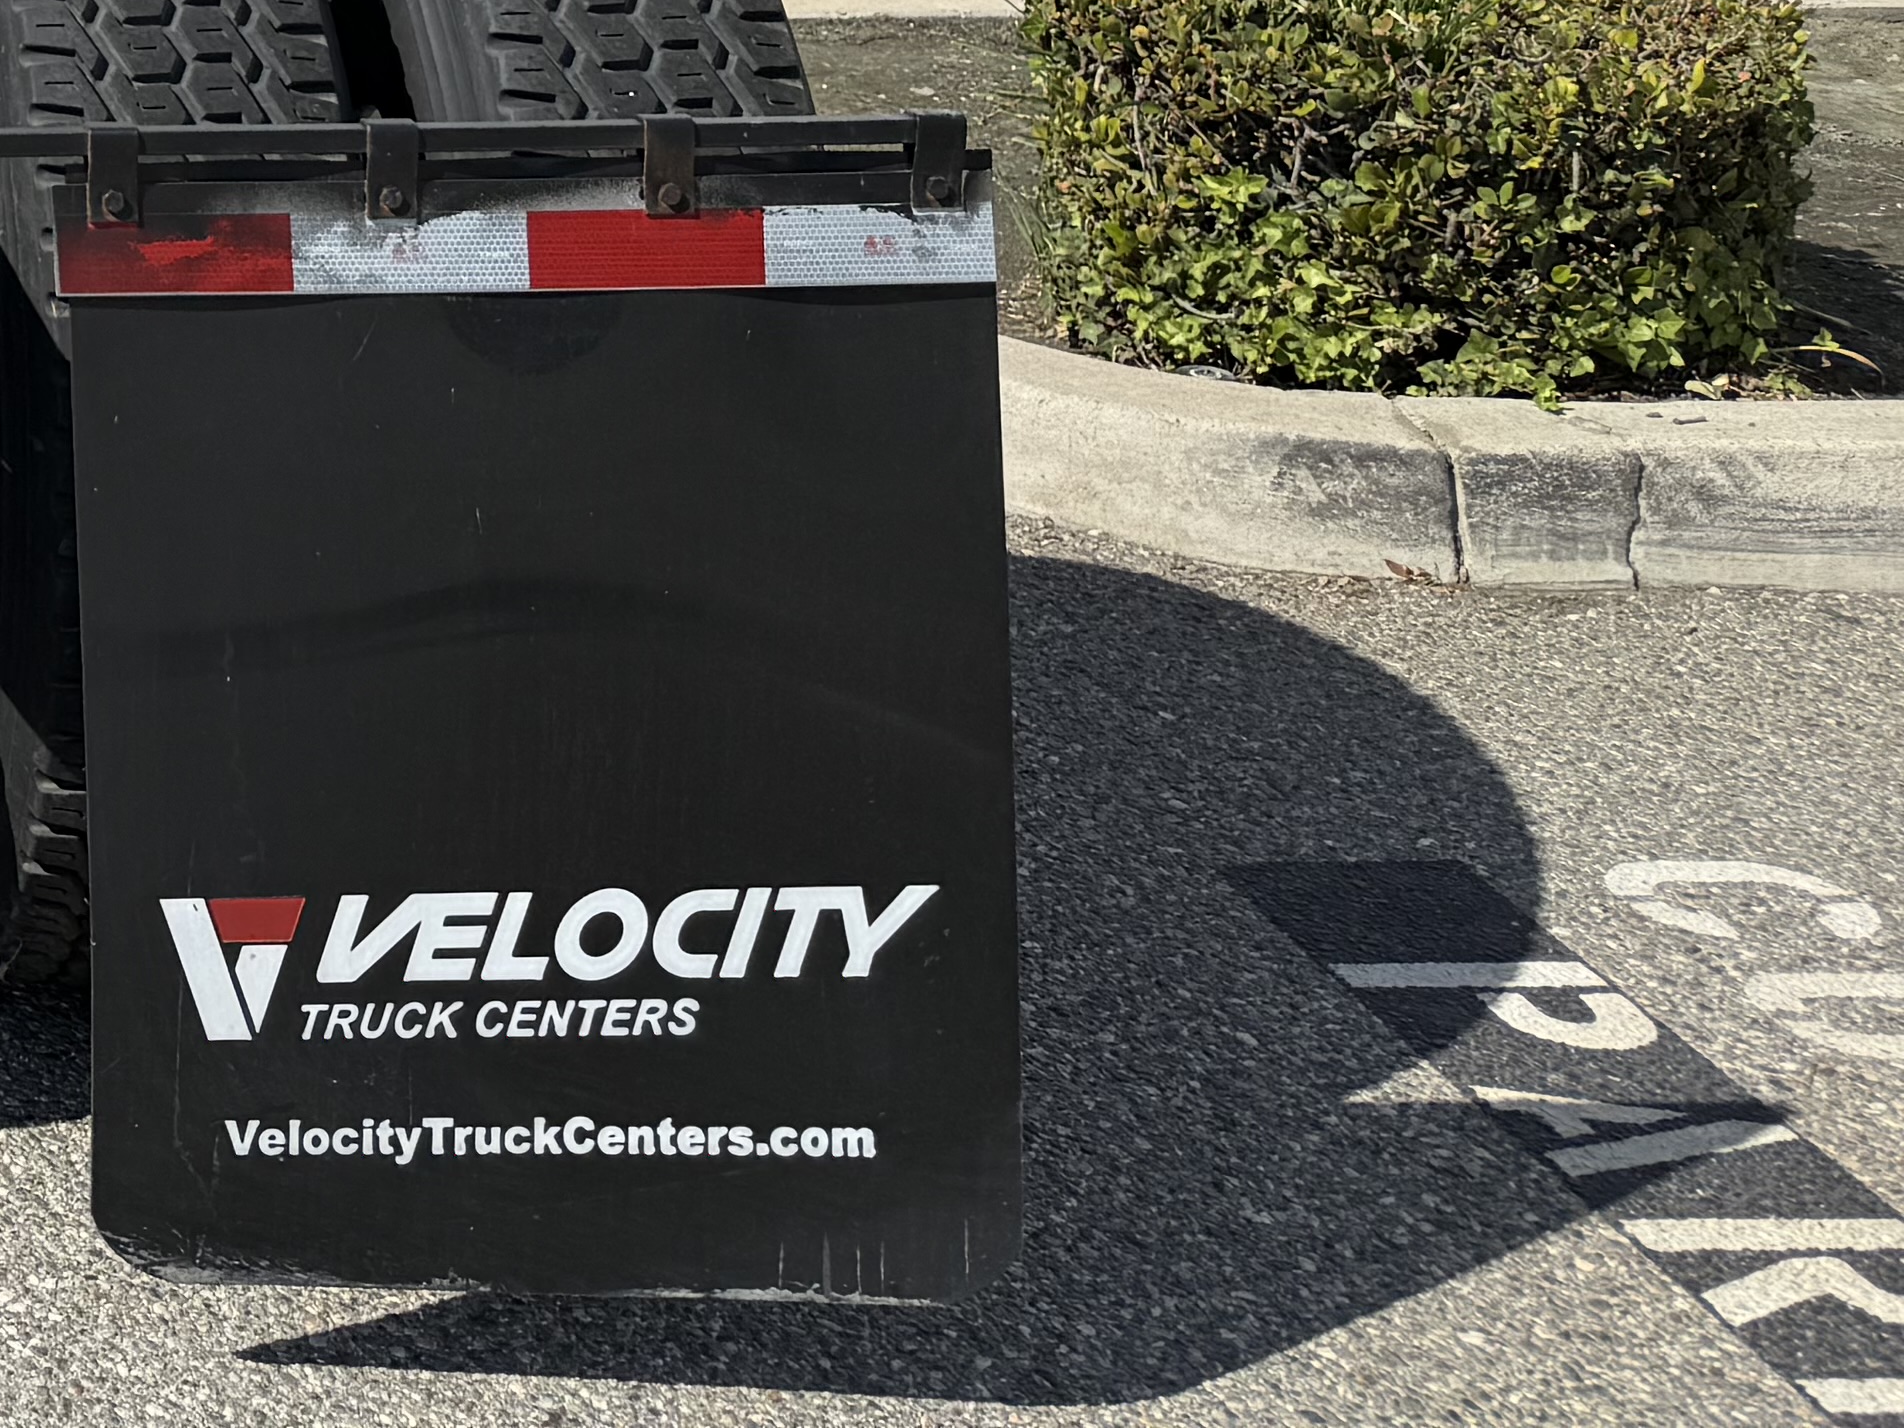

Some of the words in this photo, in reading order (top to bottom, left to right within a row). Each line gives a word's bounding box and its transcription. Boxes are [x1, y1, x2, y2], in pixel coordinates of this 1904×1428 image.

[314, 883, 941, 984] VELOCITY
[299, 1000, 464, 1041] TRUCK
[474, 997, 701, 1039] CENTERS
[223, 1115, 878, 1166] VelocityTruckCenters.com
